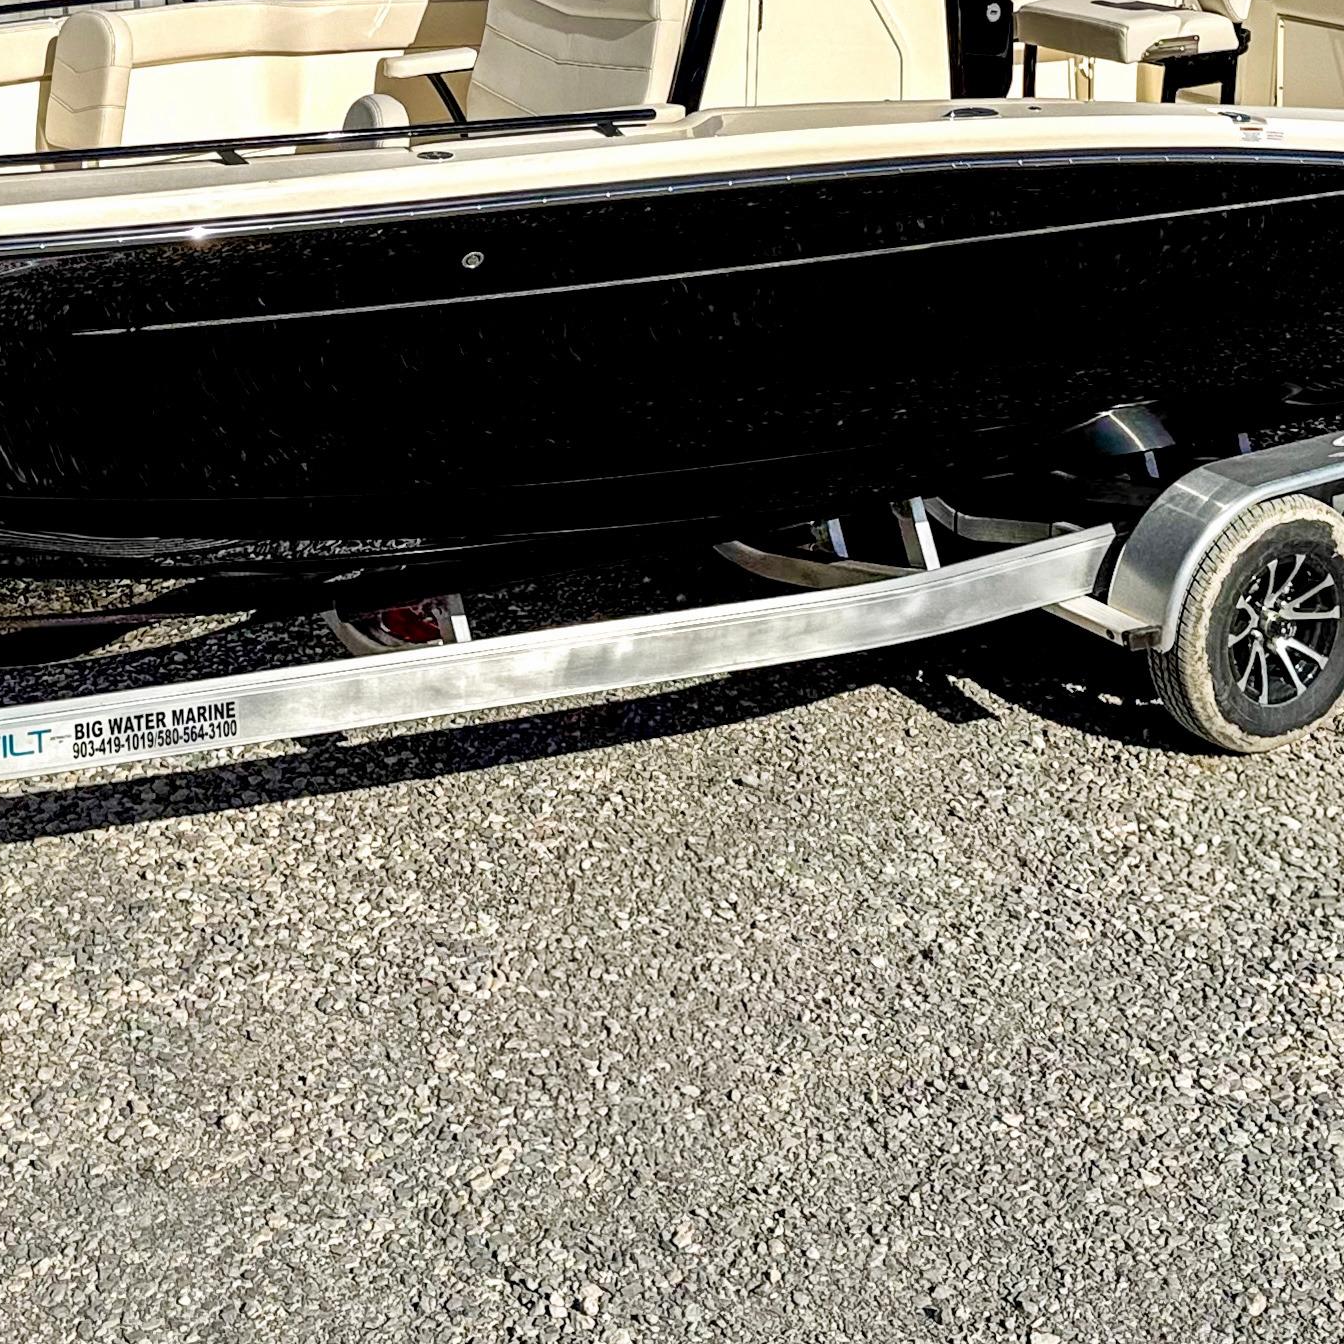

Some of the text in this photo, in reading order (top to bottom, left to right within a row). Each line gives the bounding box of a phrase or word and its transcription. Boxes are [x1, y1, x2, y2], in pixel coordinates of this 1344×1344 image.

[74, 720, 103, 740] BIG
[108, 711, 166, 735] WATER
[172, 701, 236, 726] MARINE
